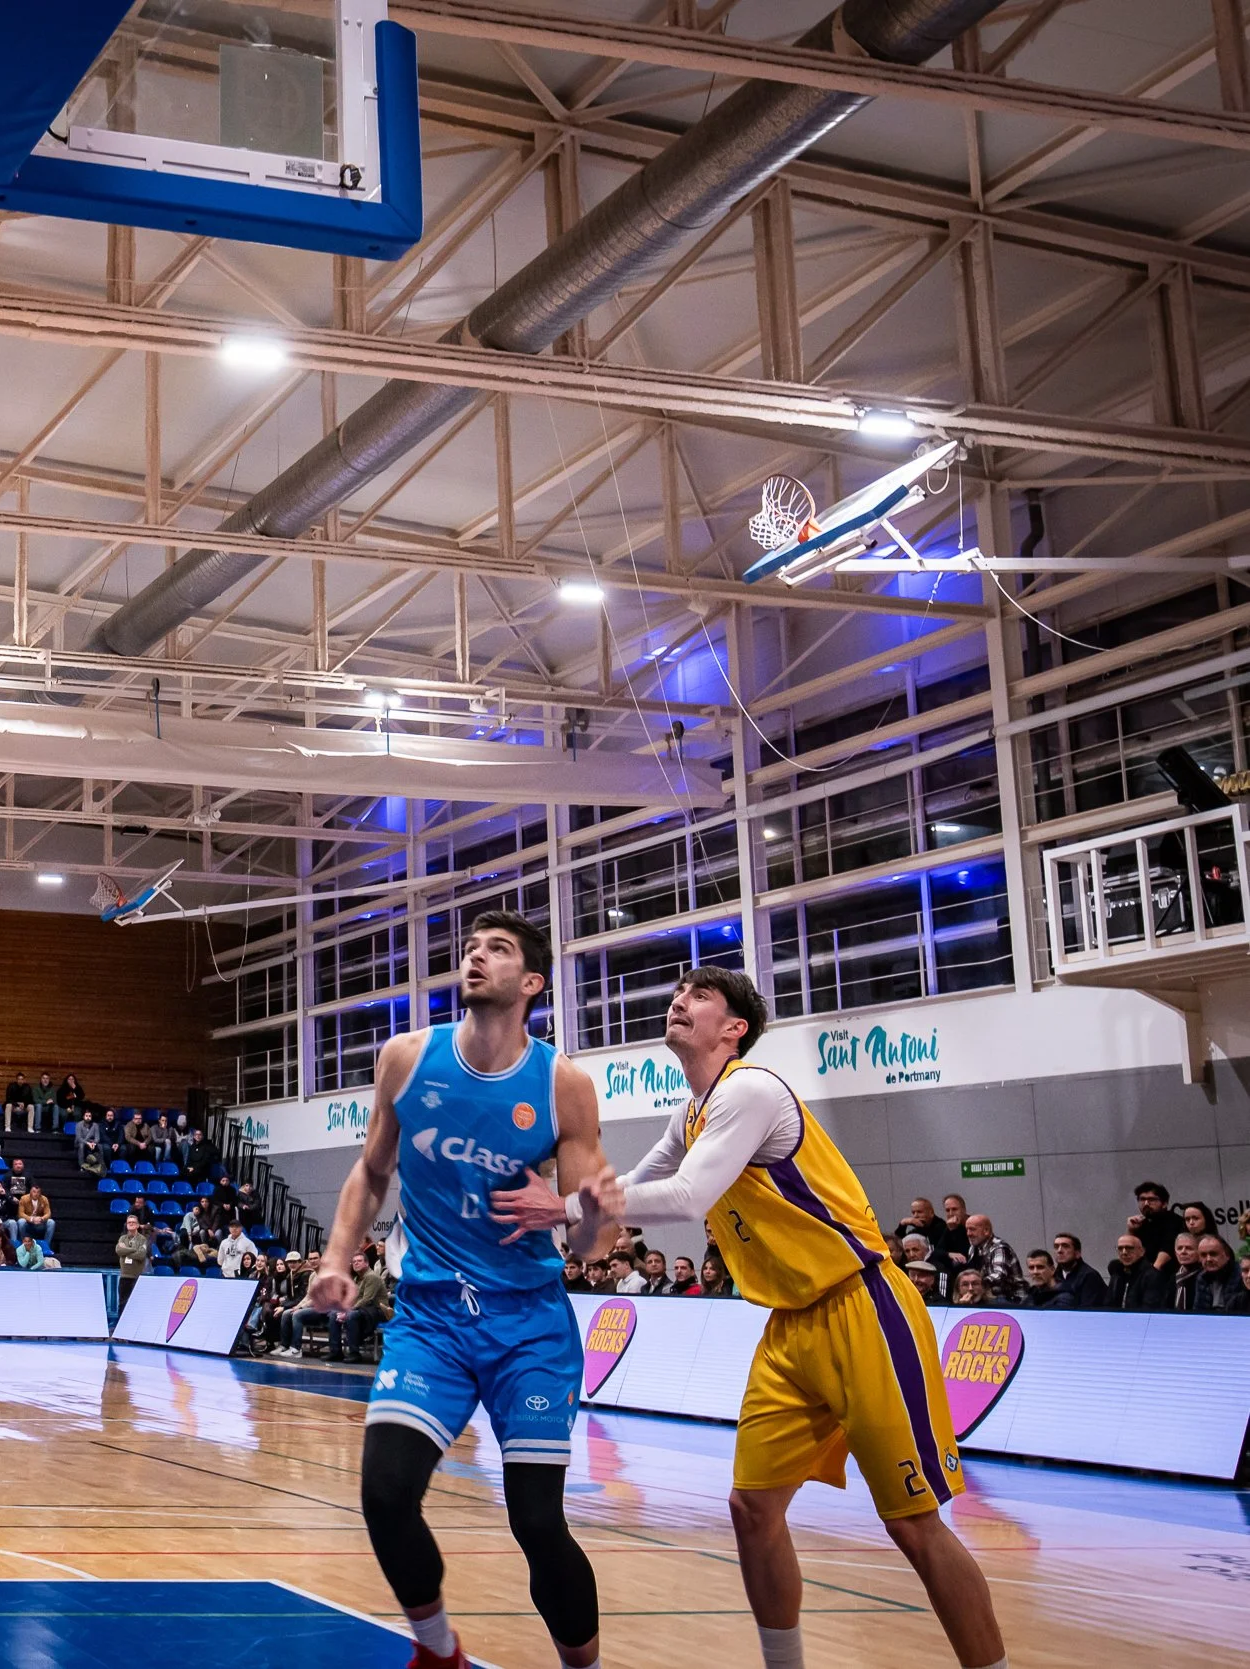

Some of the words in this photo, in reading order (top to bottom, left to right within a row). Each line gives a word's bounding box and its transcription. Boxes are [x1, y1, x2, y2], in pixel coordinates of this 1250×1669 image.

[817, 1031, 860, 1076] Sant
[864, 1025, 939, 1069] Antoni
[830, 1029, 849, 1042] Visit
[606, 1062, 637, 1099] Sant
[885, 1072, 897, 1084] de
[898, 1070, 941, 1084] Portmany
[440, 1135, 524, 1177] Class
[728, 1209, 751, 1243] 2
[596, 1307, 630, 1330] IBIZA
[590, 1328, 627, 1354] ROCKS
[957, 1324, 1011, 1354] IBIZA
[944, 1352, 1010, 1386] ROCKS
[897, 1460, 926, 1497] 2
